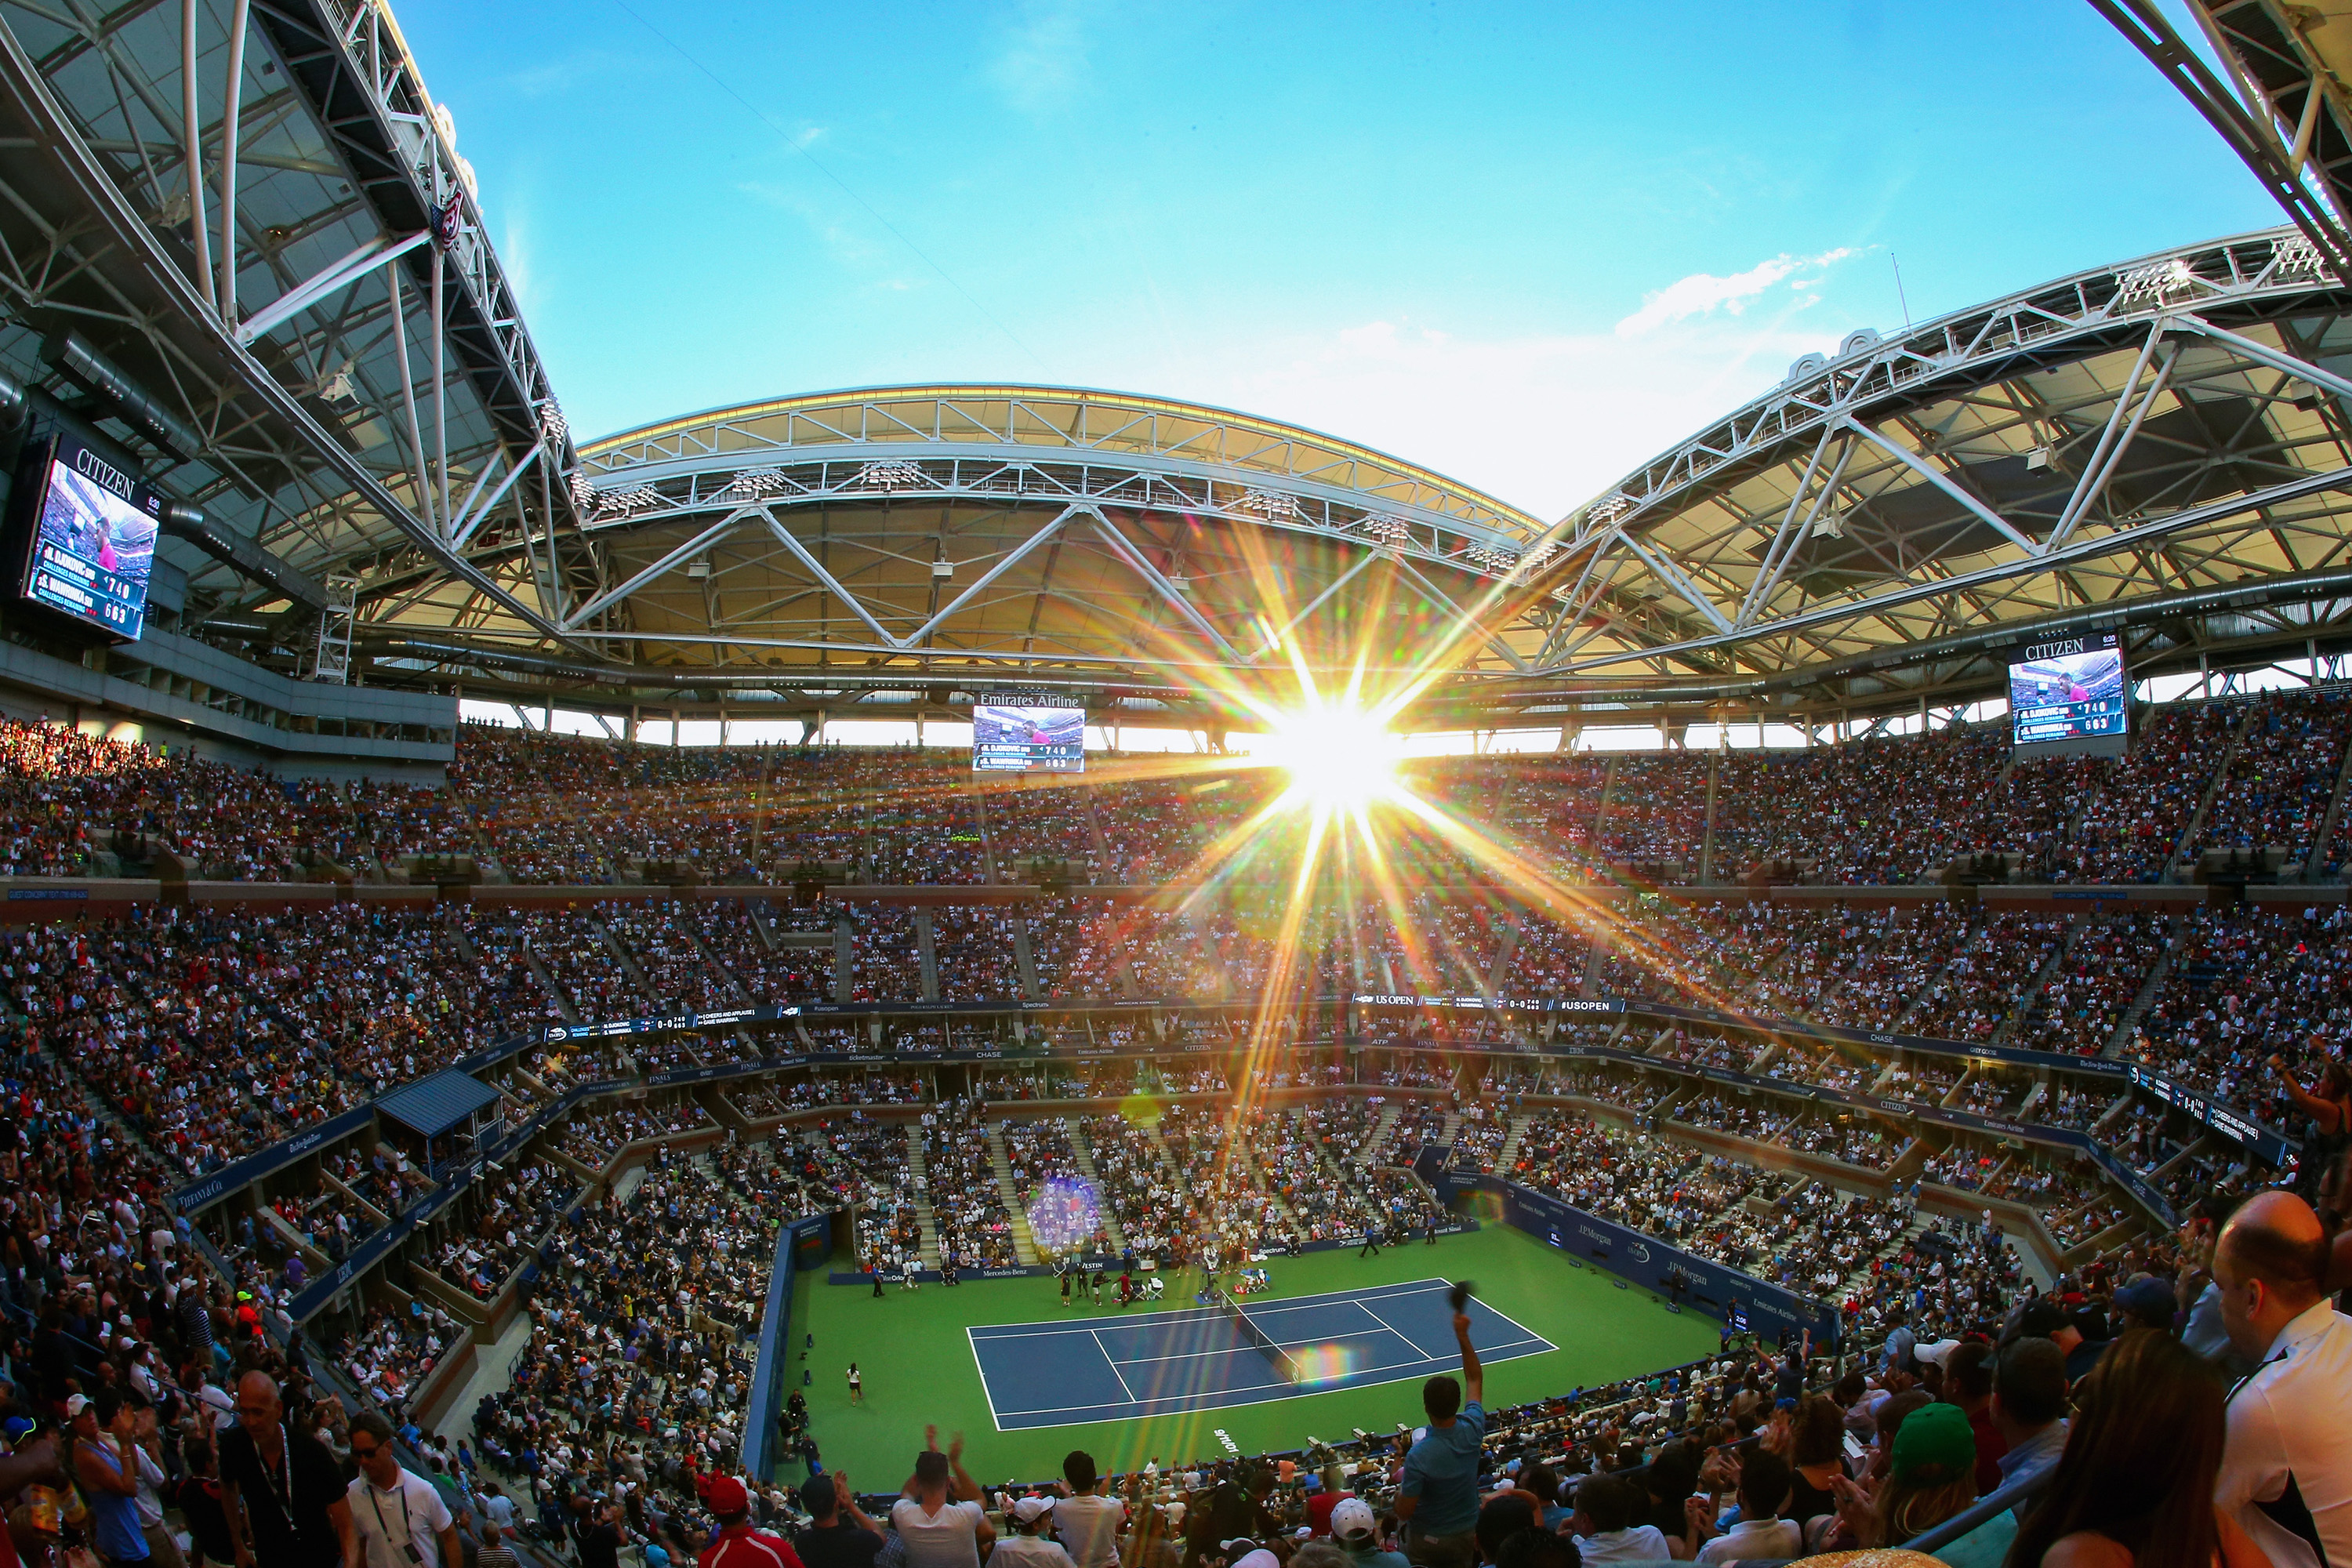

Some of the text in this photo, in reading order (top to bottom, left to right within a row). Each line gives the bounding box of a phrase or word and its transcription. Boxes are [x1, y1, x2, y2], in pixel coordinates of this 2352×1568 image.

[77, 448, 136, 501] CITIZEN
[54, 550, 86, 575] DJOKOVIC
[108, 576, 116, 593] 7
[116, 582, 122, 596] 4
[122, 584, 129, 600] 0
[49, 576, 85, 605] WAWRINKA
[104, 603, 111, 618] 6
[111, 605, 119, 621] 6
[119, 608, 126, 624] 3
[2025, 637, 2084, 660] CITIZEN
[981, 694, 1079, 707] Emirates Airline
[2030, 706, 2059, 718] DJOKOVIC
[2084, 703, 2090, 713] 7
[2092, 702, 2097, 713] 4
[2099, 702, 2106, 712] 0
[2030, 723, 2063, 734] WAWRINKA
[2085, 720, 2091, 730] 6
[2092, 719, 2100, 730] 6
[2100, 718, 2107, 729] 3
[1060, 746, 1066, 755] 0
[1052, 759, 1058, 768] 6
[1060, 759, 1066, 768] 3
[1376, 995, 1414, 1005] US OPEN
[1561, 1001, 1610, 1011] #USOPEN
[1870, 1033, 1893, 1044] CHASE
[740, 1061, 760, 1070] FINALS
[648, 1073, 671, 1083] FINALS
[1881, 1100, 1908, 1112] CITIZEN
[1984, 1120, 2024, 1134] Emirates Airline
[800, 1224, 822, 1233] AMERICAN
[800, 1229, 818, 1238] EXPRESS
[336, 1260, 353, 1284] IBM
[983, 1269, 1028, 1277] Mercedes-Benz
[1667, 1261, 1708, 1286] J.PMorgan
[1753, 1298, 1777, 1314] Emirates
[1777, 1308, 1797, 1322] Airline
[1214, 1428, 1239, 1453] 9/11/01
